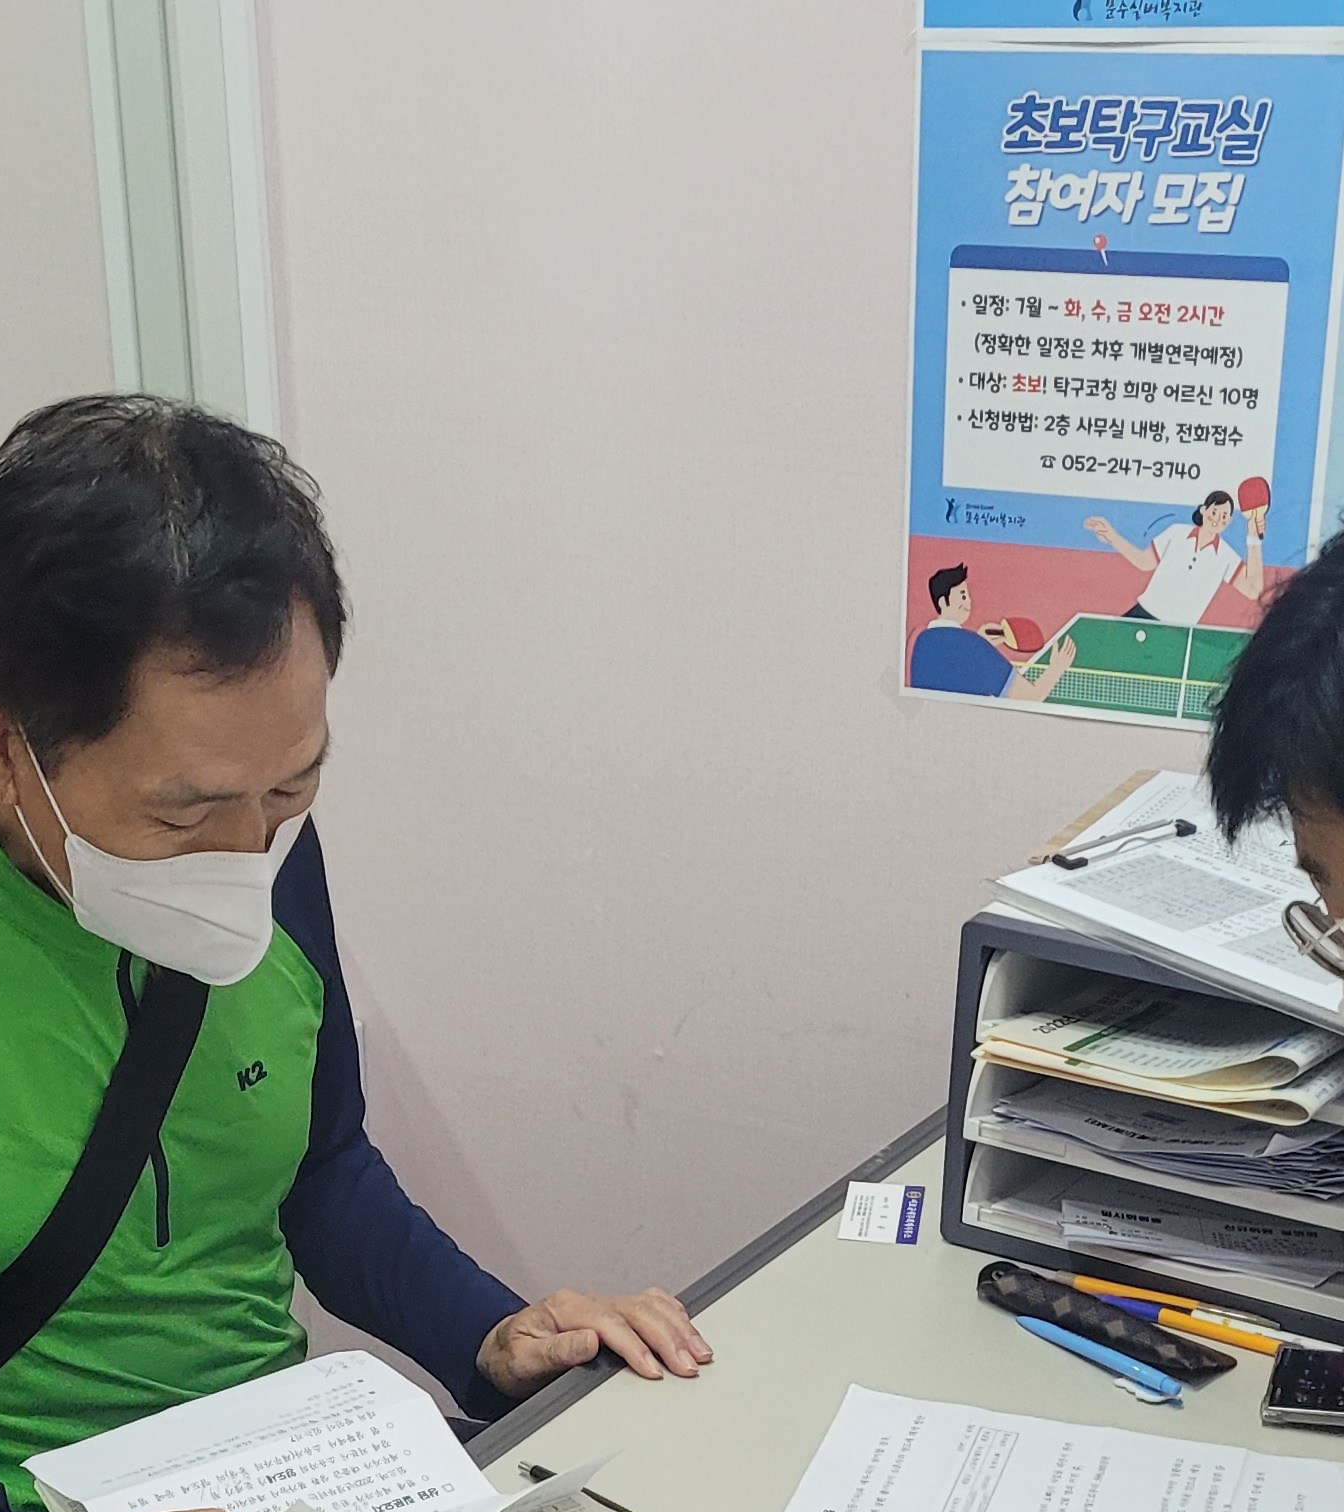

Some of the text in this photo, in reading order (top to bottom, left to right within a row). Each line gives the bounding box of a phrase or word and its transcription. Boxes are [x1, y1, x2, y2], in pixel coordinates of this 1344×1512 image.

[1002, 91, 1272, 164] 초보탁구교실
[1003, 163, 1245, 233] 참여자 모집
[973, 293, 1010, 317] 일정:
[1015, 296, 1042, 318] 7월
[1063, 299, 1085, 321] 화,
[1091, 300, 1110, 323] 수,
[1117, 301, 1133, 322] 금
[1138, 302, 1171, 324] 오전
[1177, 303, 1225, 327] 2시간
[974, 332, 1244, 369] (정확한 일정은 차후 개별연락예정)
[969, 372, 1259, 410] 대상: 초보! 탁구코칭 희망 어르신 10명
[967, 409, 1244, 446] 신청방법: 2층 사무실 내방, 전화접수
[1061, 454, 1201, 480] 052-247-3740
[236, 1060, 268, 1091] K2
[414, 1486, 442, 1500] 상담
